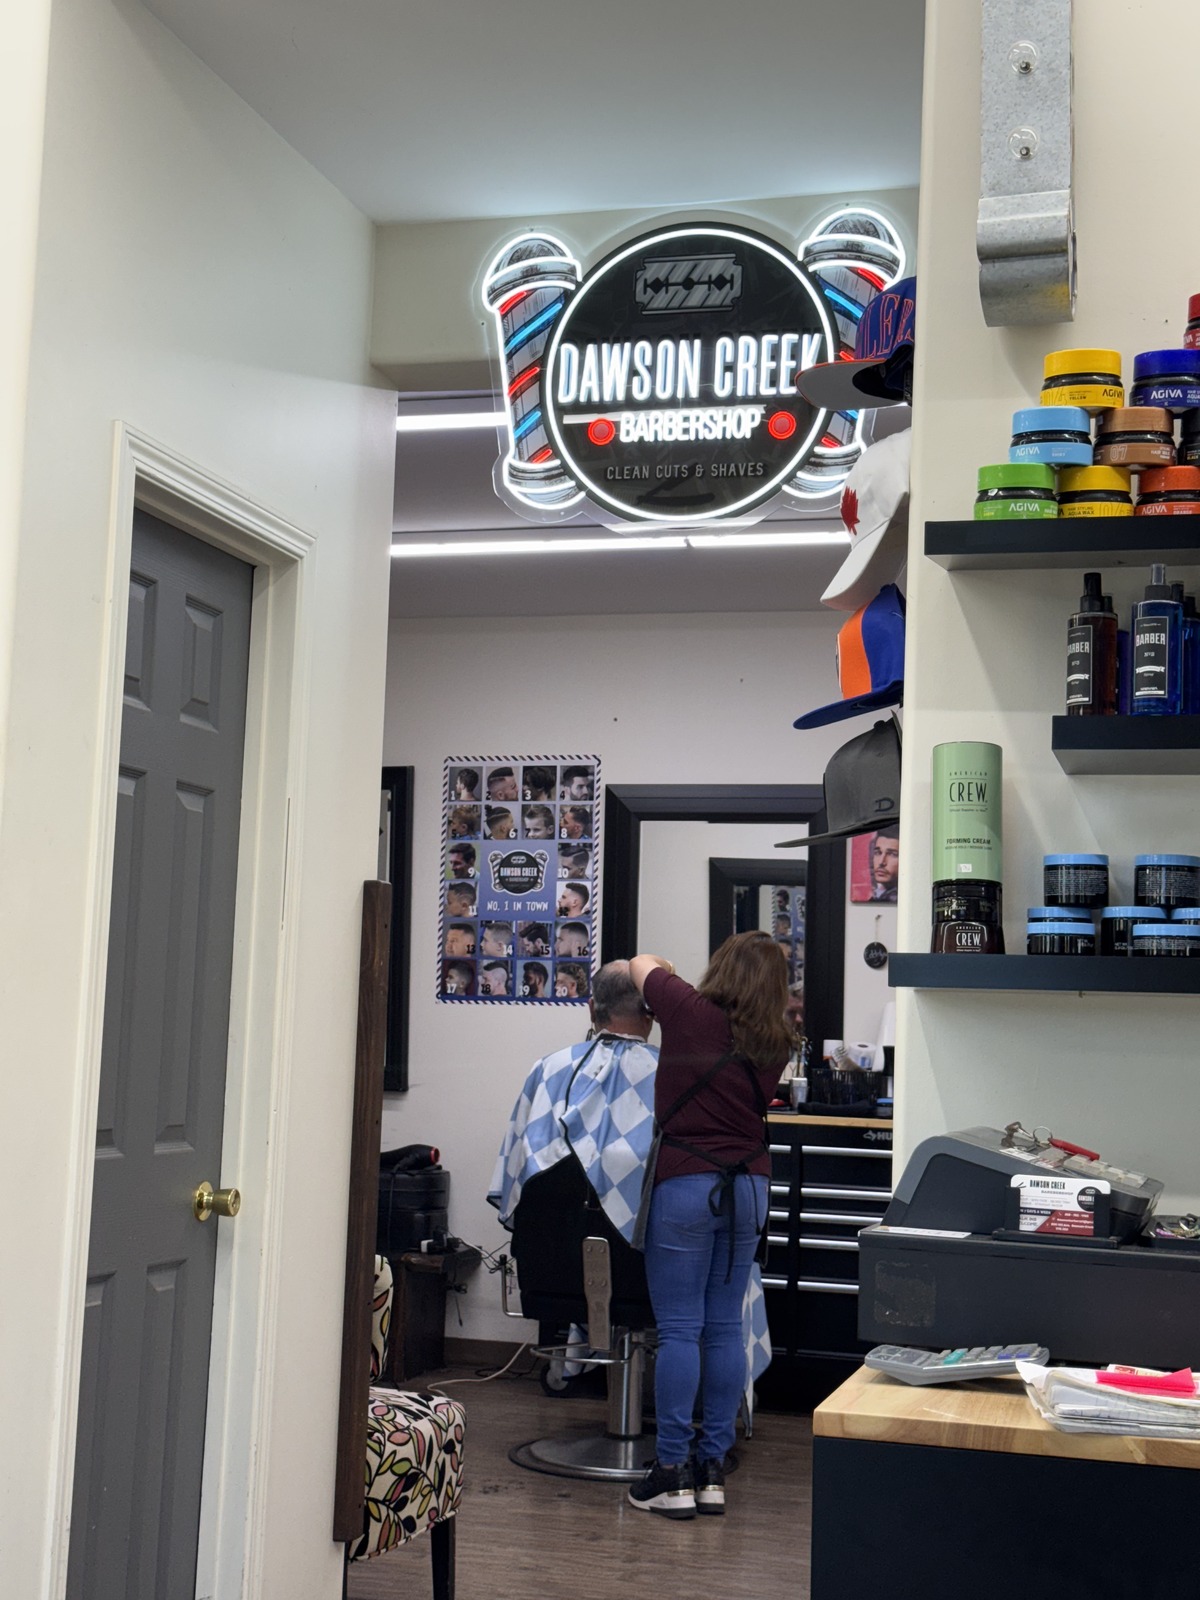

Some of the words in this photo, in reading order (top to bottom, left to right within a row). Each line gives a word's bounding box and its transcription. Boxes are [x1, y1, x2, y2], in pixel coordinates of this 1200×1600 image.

[558, 338, 699, 404] DAWSON
[713, 333, 823, 397] CREEK
[1150, 389, 1183, 400] AGIVA
[619, 408, 761, 443] BARBERSHOP
[1015, 446, 1040, 457] AGIVA
[1110, 445, 1127, 462] 07
[606, 466, 649, 480] CLEAN
[655, 464, 690, 479] CUTS
[695, 464, 704, 477] &
[711, 462, 764, 477] SHAVES
[1009, 503, 1040, 512] AGIVA
[1142, 505, 1168, 515] AGIVA
[1136, 633, 1166, 647] BARBER
[450, 790, 456, 800] 1
[485, 791, 491, 801] 2
[524, 790, 532, 800] 3
[560, 790, 566, 800] 4
[508, 828, 516, 838] 6
[560, 828, 568, 838] 8
[467, 867, 475, 878] 9
[521, 867, 538, 876] CREEK
[558, 868, 569, 878] 10
[468, 906, 477, 916] 11
[487, 901, 500, 912] NO.
[504, 901, 509, 911] 1
[513, 902, 522, 911] IN
[526, 901, 549, 912] TOWN
[503, 944, 513, 956] 14
[540, 945, 550, 956] 15
[577, 946, 588, 956] 16
[446, 983, 457, 994] 17
[481, 983, 491, 994] 18
[519, 985, 530, 996] 19
[555, 986, 568, 996] 20
[1030, 1180, 1050, 1188] DAWSON
[1051, 1181, 1065, 1190] CREEK
